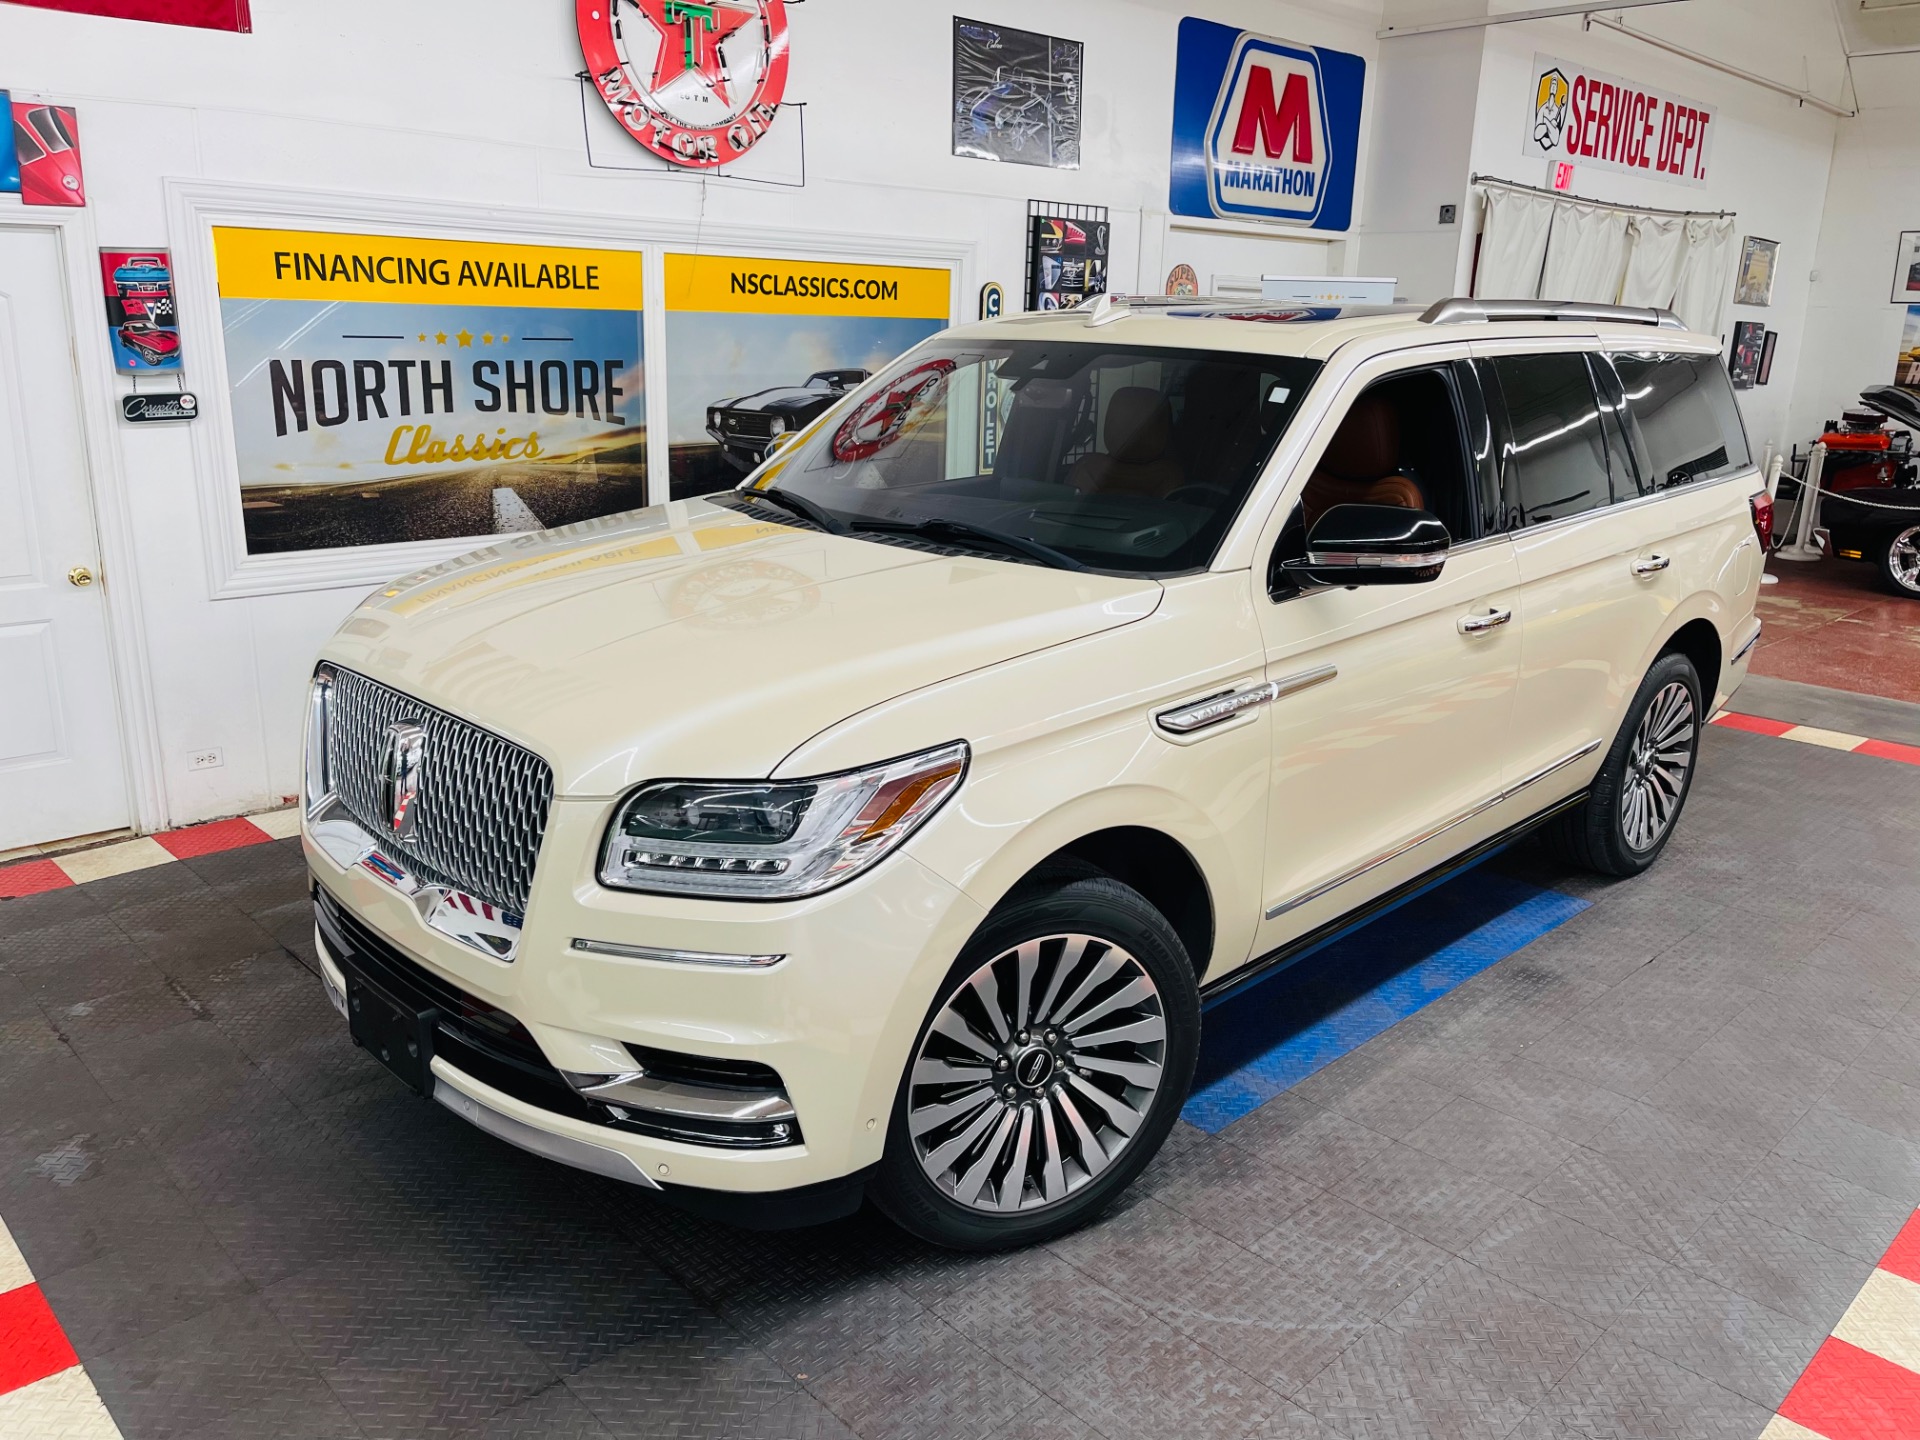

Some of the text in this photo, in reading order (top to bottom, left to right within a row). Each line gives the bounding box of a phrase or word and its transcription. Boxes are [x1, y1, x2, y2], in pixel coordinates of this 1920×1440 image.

[598, 66, 779, 163] MOTOR OIL
[1231, 64, 1313, 164] M
[1566, 75, 1710, 180] SERVICE DEPT.
[1224, 160, 1315, 197] MARATHON
[1555, 162, 1575, 190] EXIT
[274, 251, 600, 290] FINANCING AVAILABLE
[731, 272, 898, 301] NSCLASSICS.COM
[1168, 266, 1195, 289] SUPER
[124, 397, 183, 418] Corvette
[269, 358, 626, 437] NORTH SHORE
[384, 424, 545, 466] Classics
[1190, 689, 1271, 722] NAVIGATOR
